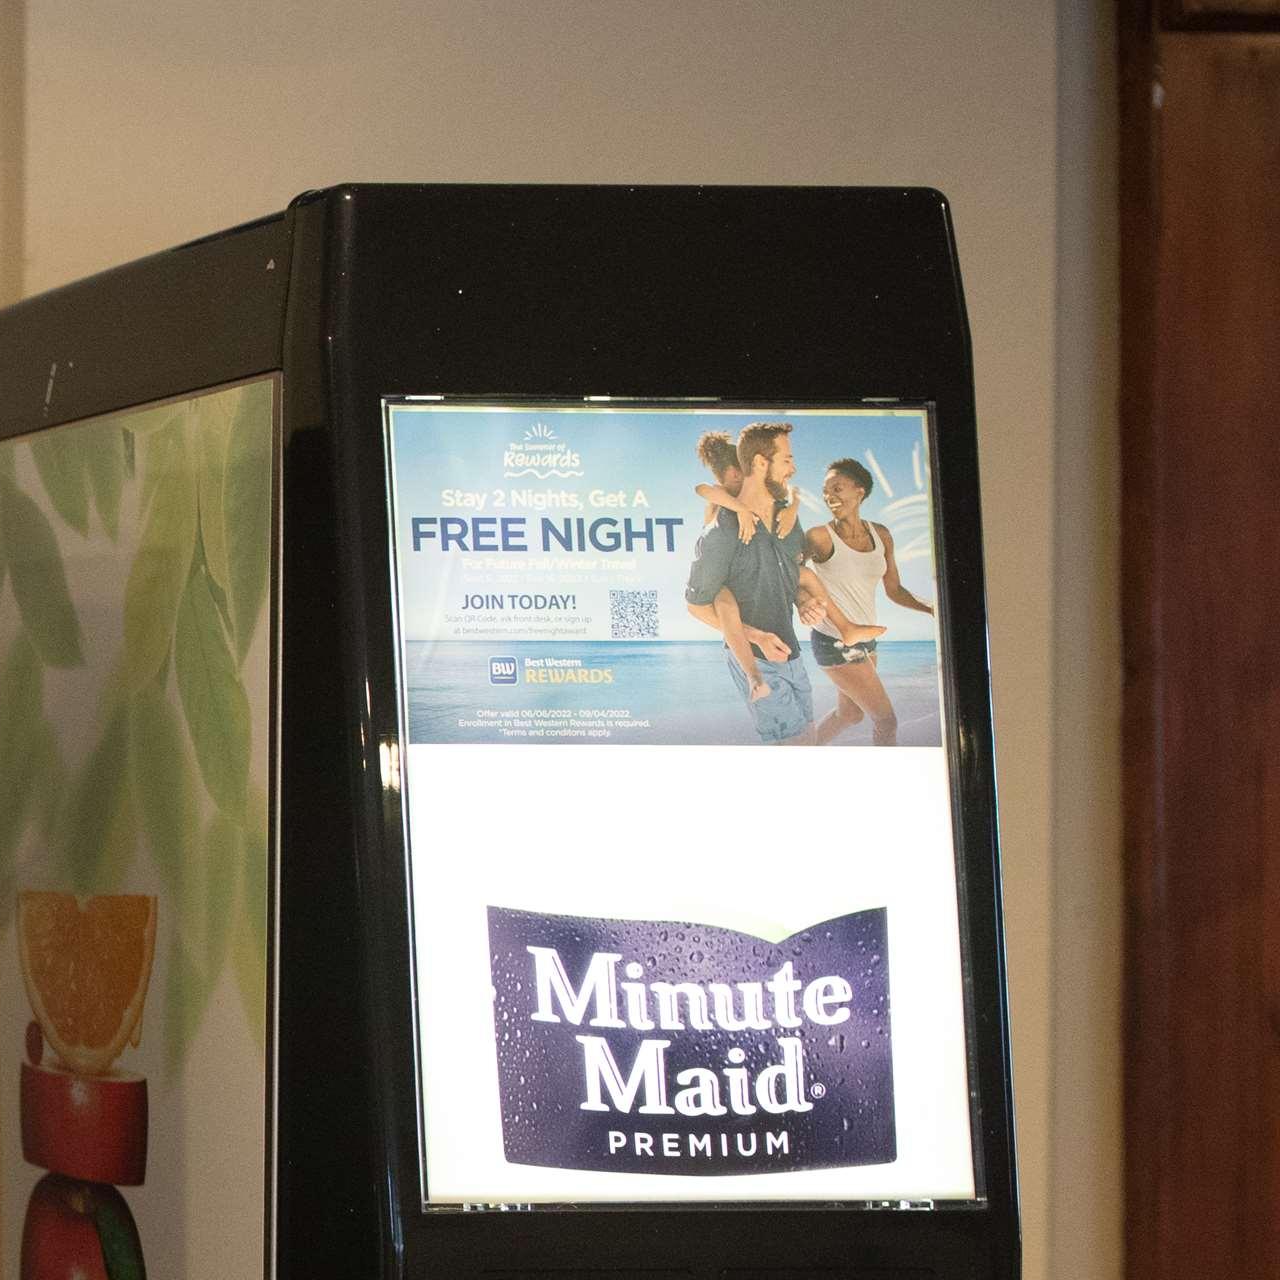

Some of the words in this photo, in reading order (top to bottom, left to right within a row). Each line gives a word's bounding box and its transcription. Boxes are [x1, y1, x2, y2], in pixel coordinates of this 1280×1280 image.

[504, 449, 580, 467] Rewards
[441, 489, 487, 511] Stay
[493, 489, 506, 507] 2
[511, 489, 583, 511] Nights,
[589, 489, 627, 508] Get
[632, 490, 649, 507] A
[412, 517, 527, 552] FREE
[542, 517, 683, 552] NIGHT
[462, 594, 504, 610] JOIN
[508, 594, 577, 610] TODAY!
[492, 662, 515, 675] BW
[524, 658, 543, 667] Best
[545, 658, 581, 667] Western
[525, 668, 614, 684] REWARDS
[501, 710, 518, 718] valid
[458, 719, 503, 728] Enrollment
[513, 719, 532, 727] Best
[534, 719, 568, 728] Western
[570, 719, 606, 728] Rewards
[529, 729, 544, 737] and
[526, 945, 854, 1032] Minute
[608, 1130, 791, 1158] PREMIUM
